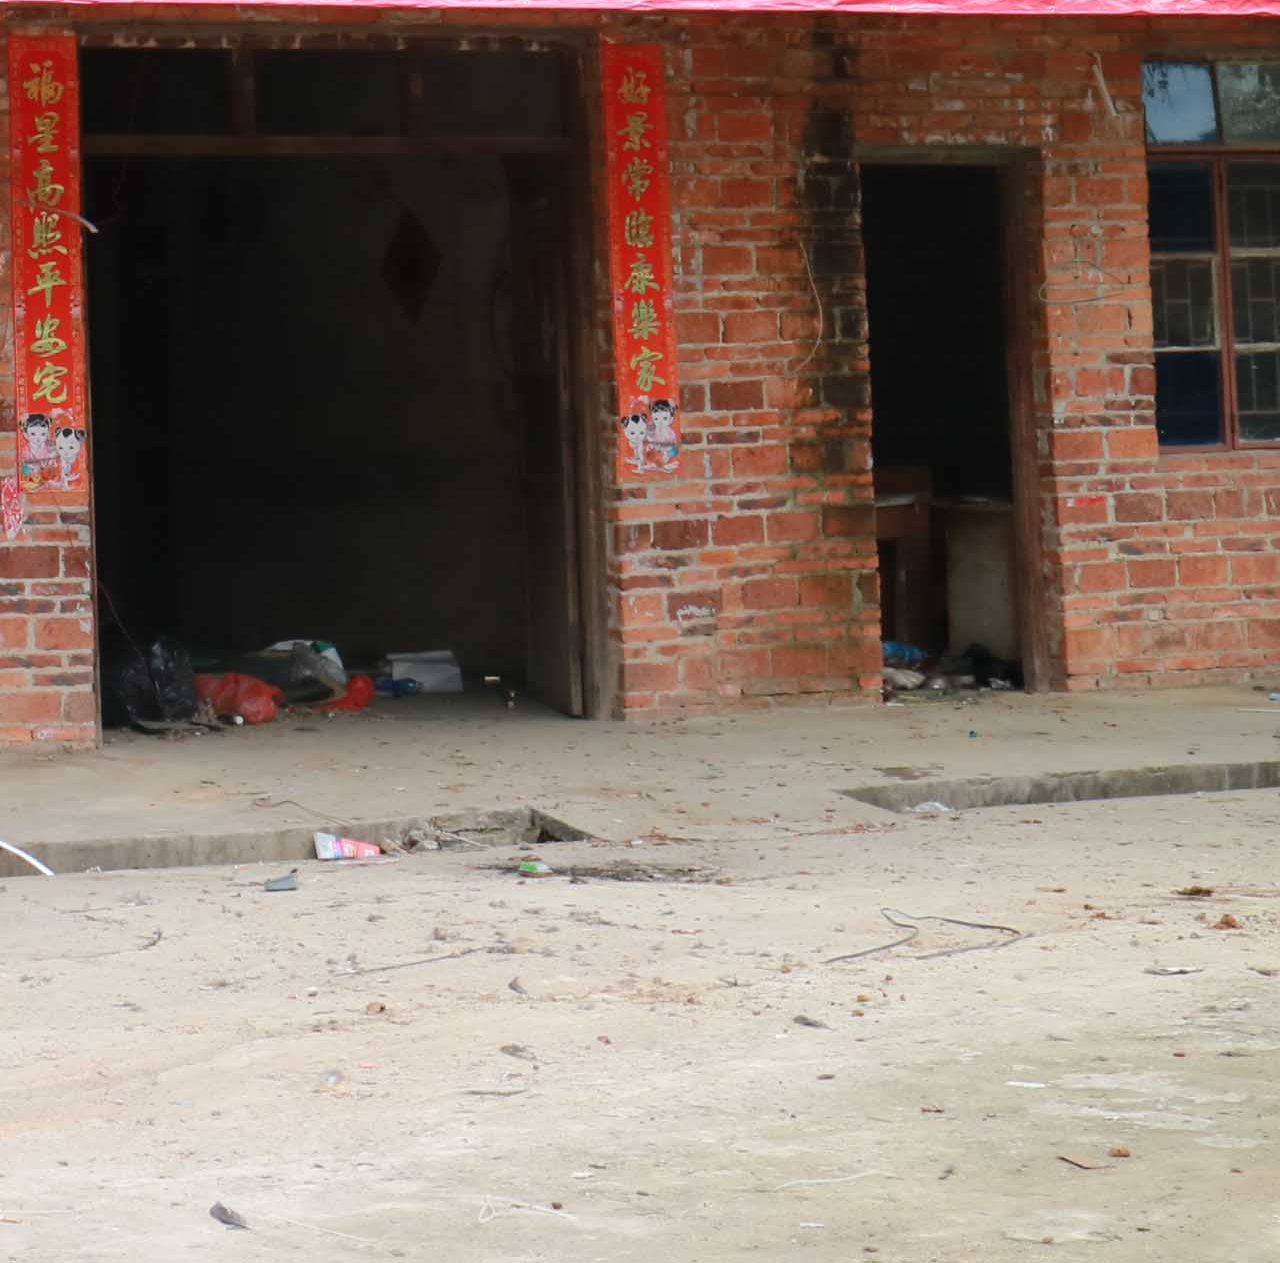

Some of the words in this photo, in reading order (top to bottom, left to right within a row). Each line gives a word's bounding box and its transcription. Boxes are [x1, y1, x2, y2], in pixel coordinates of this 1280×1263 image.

[22, 59, 69, 405] 福星高照平安宅
